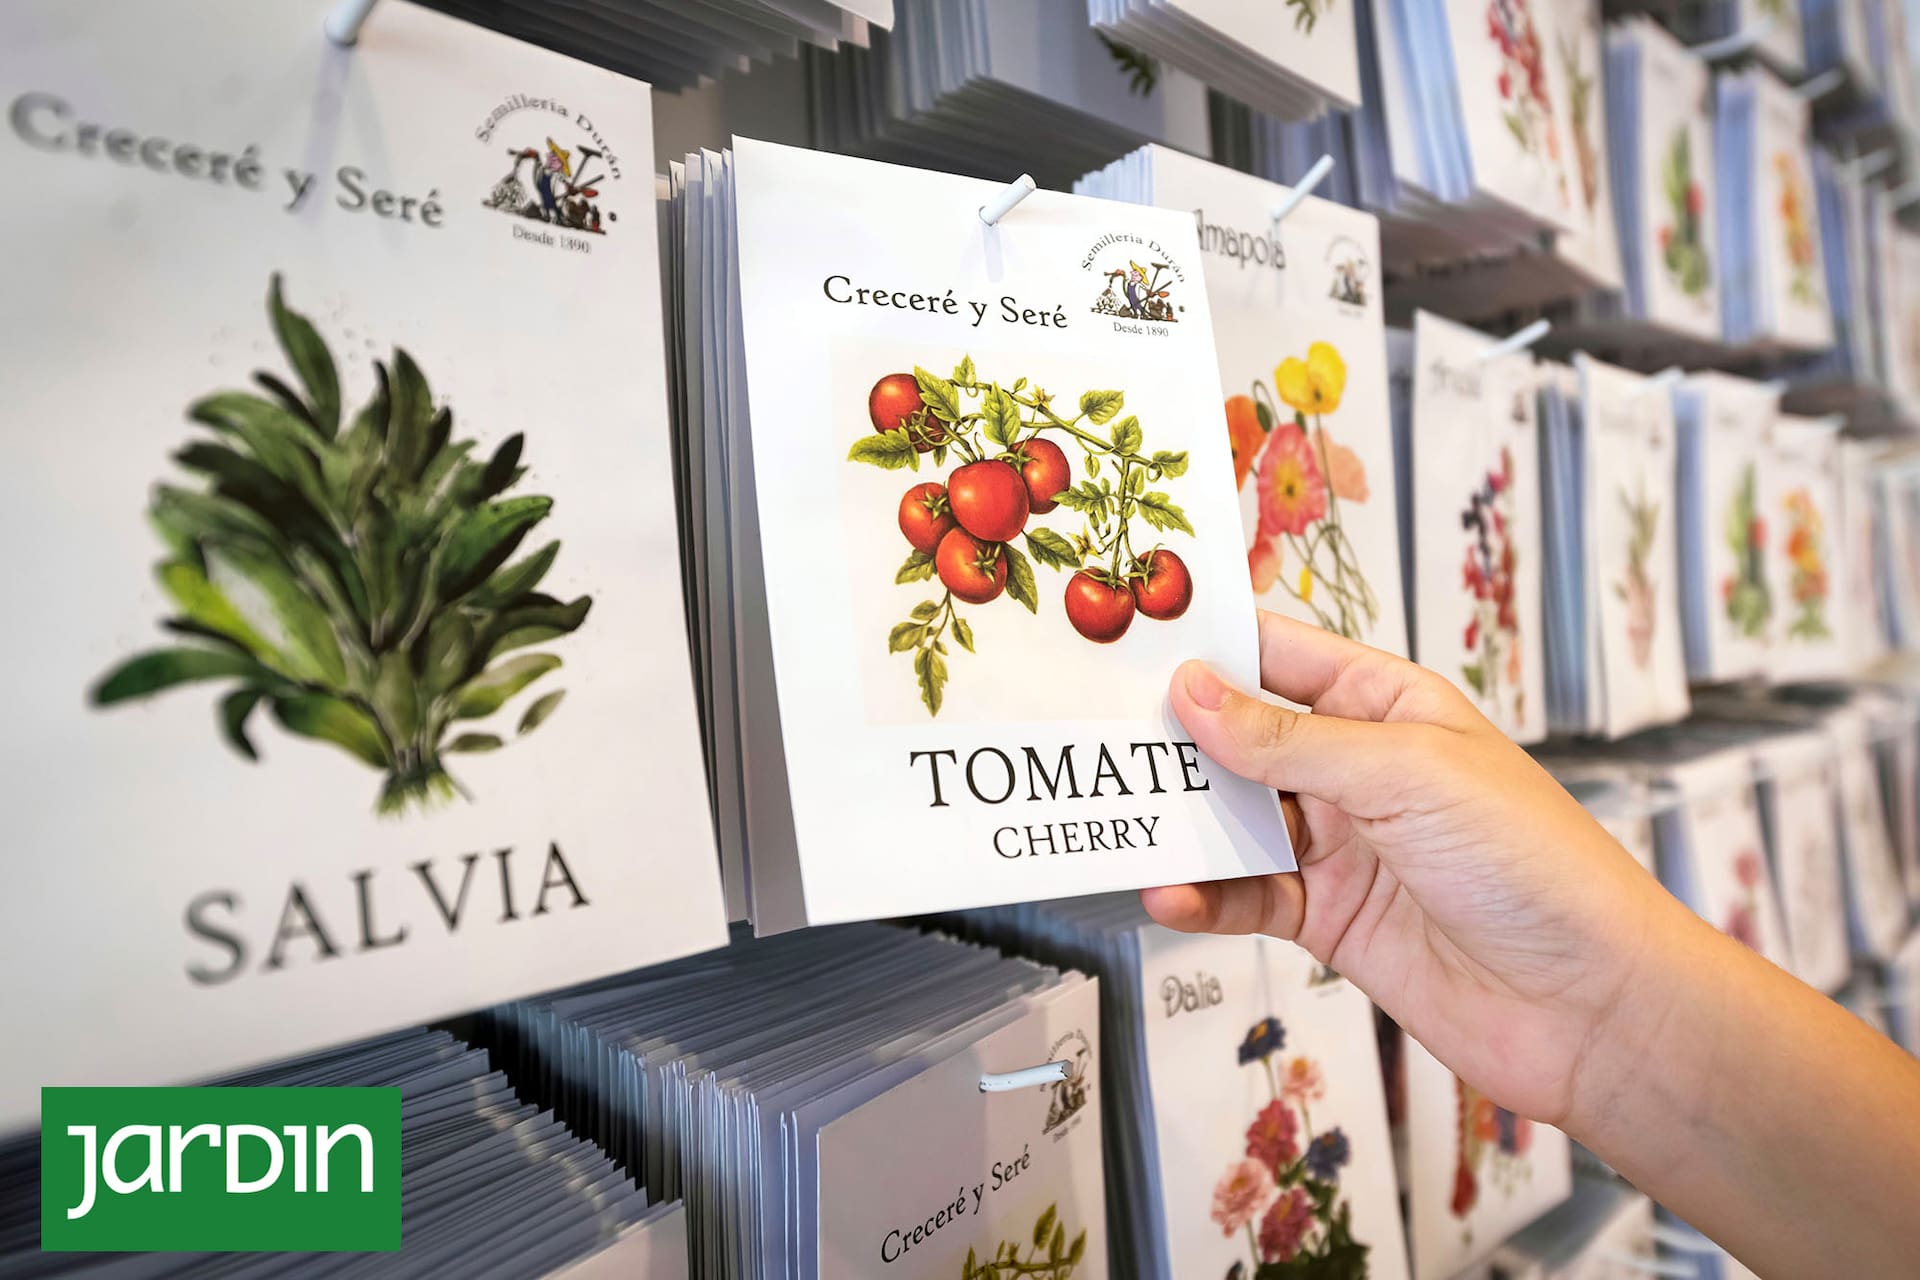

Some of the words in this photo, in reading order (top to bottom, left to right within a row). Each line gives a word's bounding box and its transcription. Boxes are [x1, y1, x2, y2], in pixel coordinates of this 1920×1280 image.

[8, 91, 265, 192] Creceré
[283, 168, 317, 214] y
[335, 165, 445, 228] Seré
[1082, 232, 1143, 271] Semilleria
[1149, 240, 1185, 283] Durán
[823, 275, 959, 315] Creceré
[968, 301, 987, 327] y
[1000, 296, 1069, 329] Seré
[1113, 321, 1143, 335] Desde
[1146, 325, 1169, 337] 1890
[909, 741, 1211, 808] TOMATE
[992, 816, 1161, 859] CHERRY
[182, 839, 592, 987] SALVIA
[1160, 972, 1224, 1018] Dalia
[881, 1186, 967, 1264] Creceré
[972, 1182, 985, 1216] y
[991, 1143, 1031, 1193] Seré
